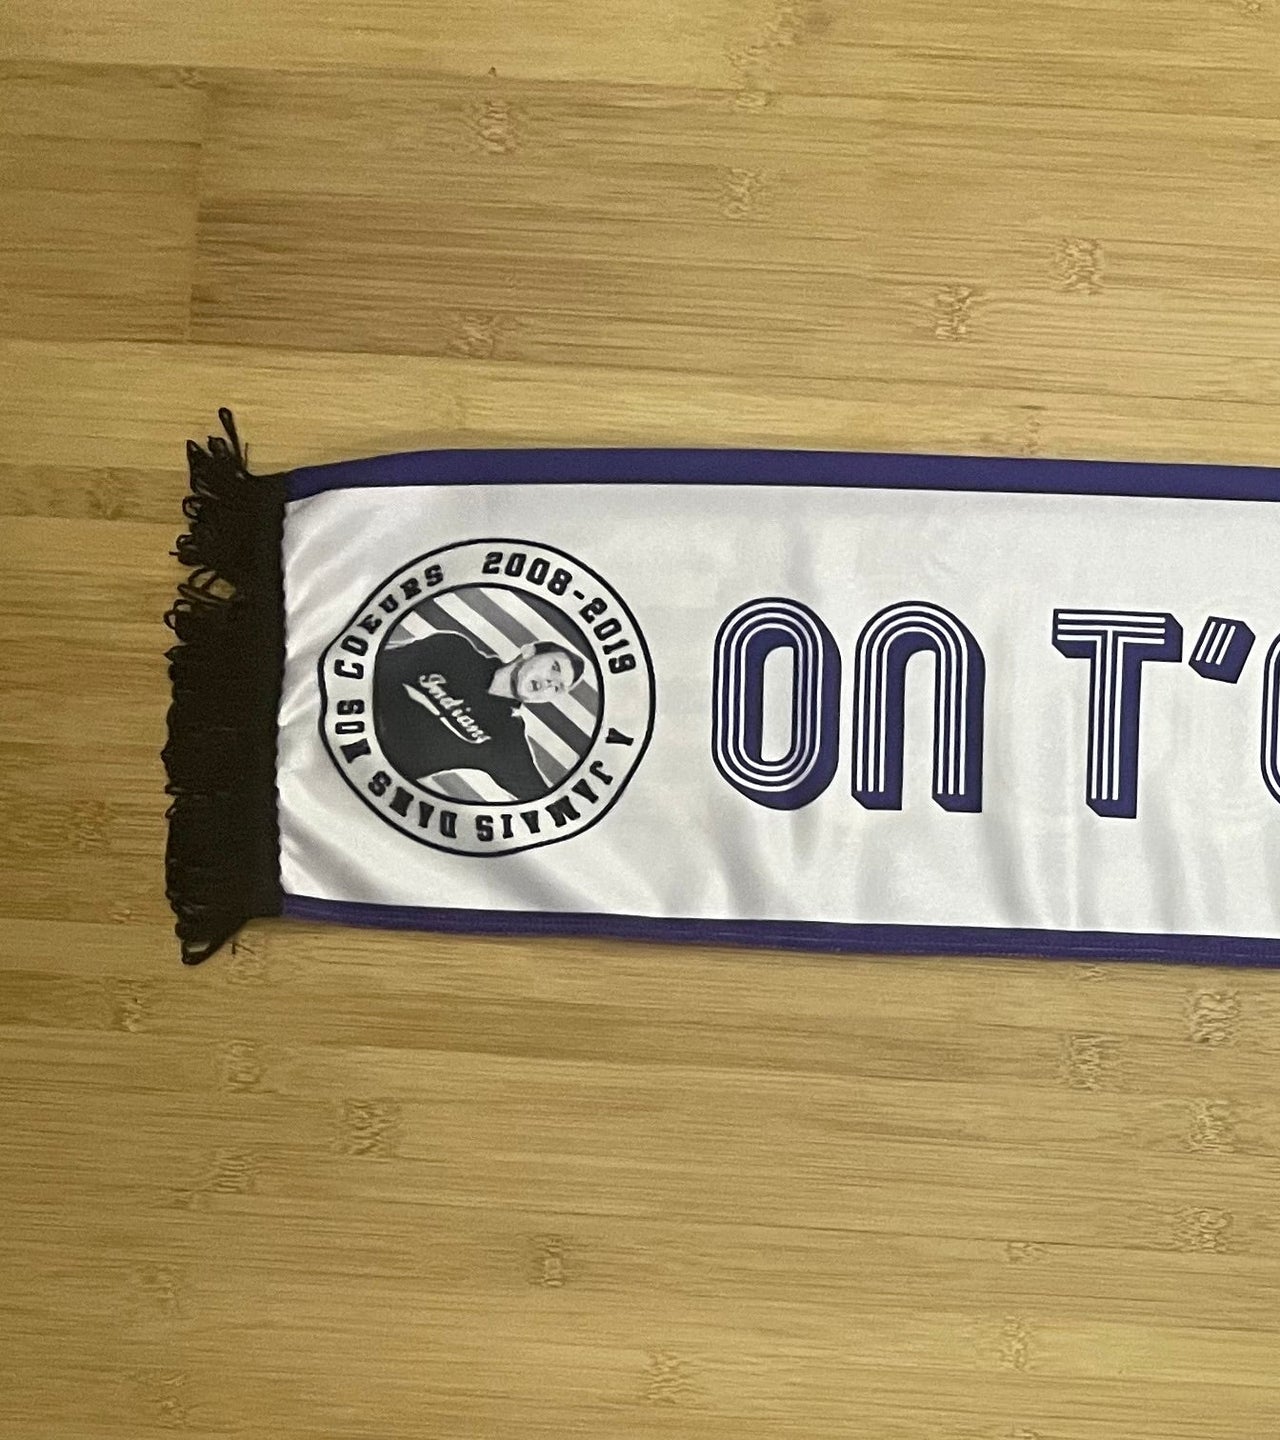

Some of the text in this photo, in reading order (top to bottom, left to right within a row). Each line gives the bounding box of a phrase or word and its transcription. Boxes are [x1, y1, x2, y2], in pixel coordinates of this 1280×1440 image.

[334, 552, 636, 842] A JAMAIS DANS NOS COEURS 2008-2019
[711, 596, 986, 813] ON
